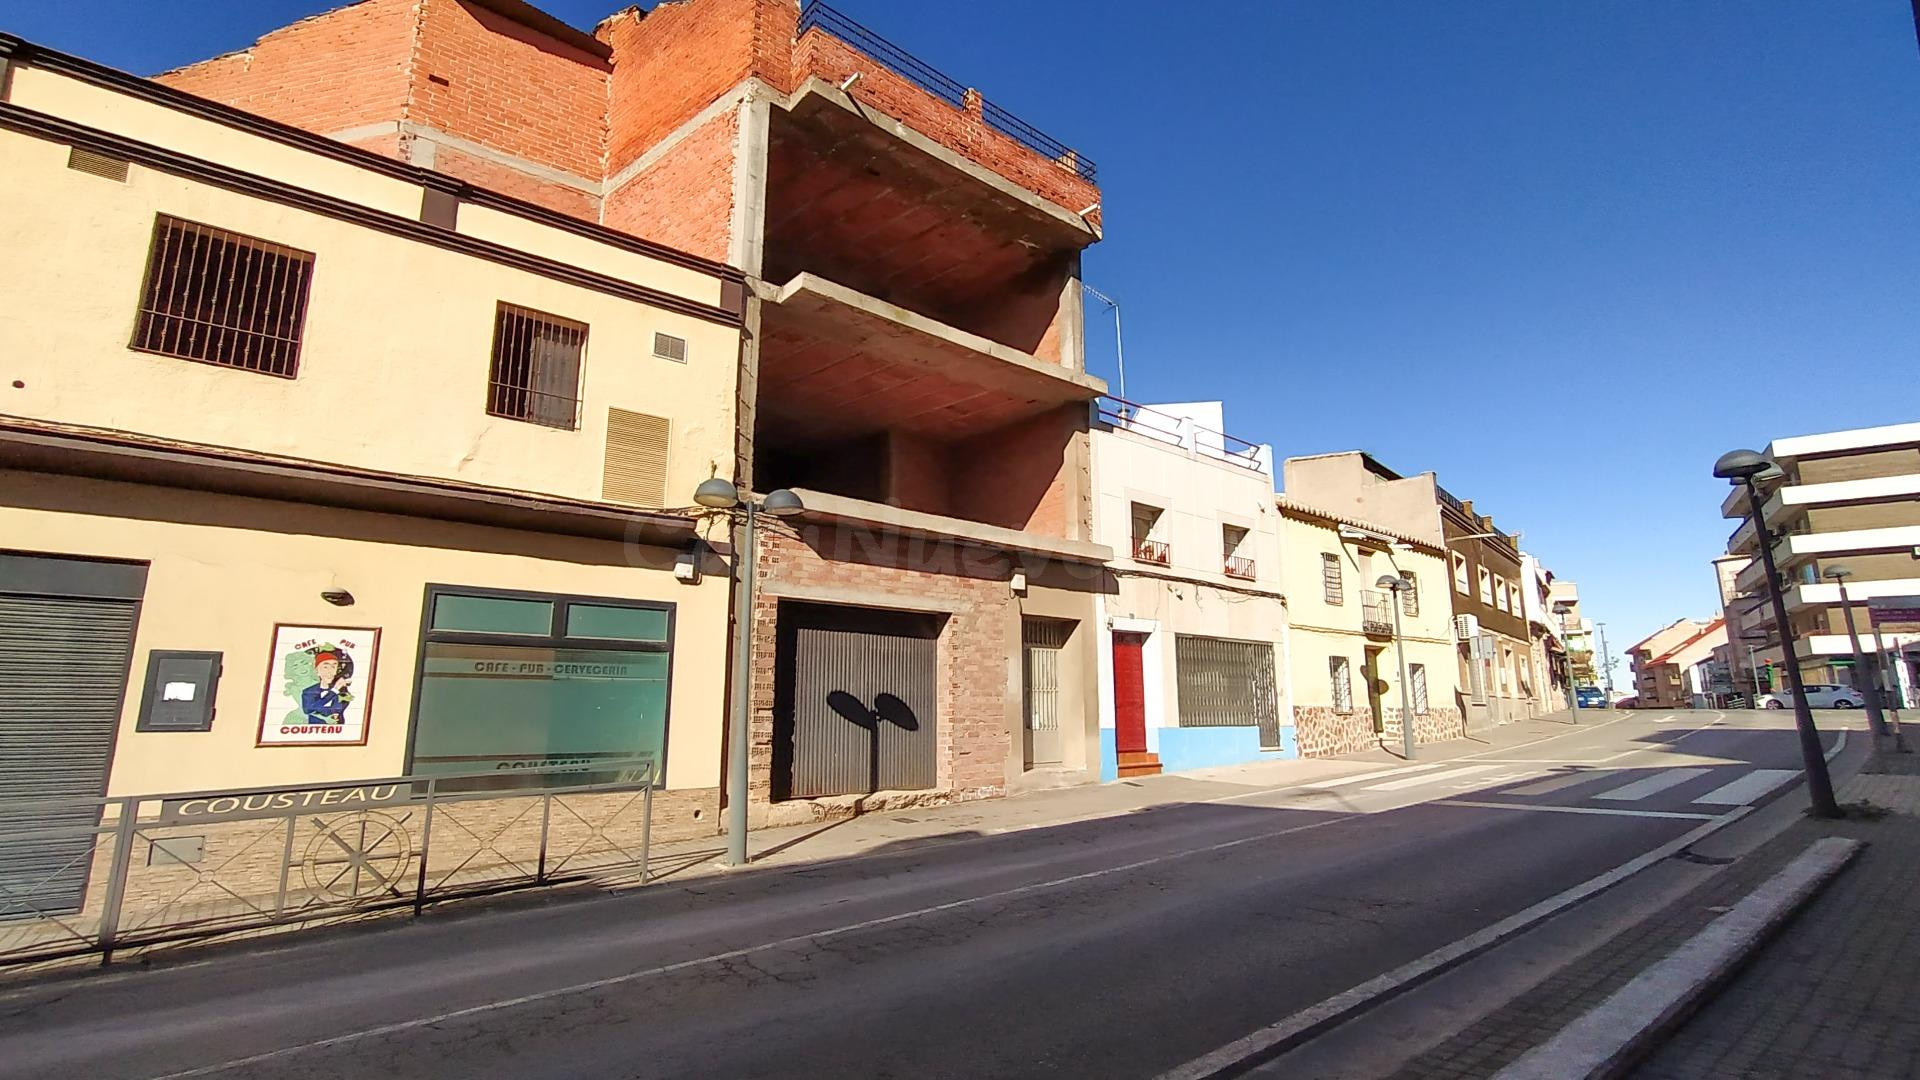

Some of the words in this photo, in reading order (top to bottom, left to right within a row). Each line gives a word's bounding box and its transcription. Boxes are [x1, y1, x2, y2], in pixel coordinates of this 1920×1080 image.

[294, 639, 316, 650] CAFE
[339, 639, 355, 649] PUB
[475, 662, 509, 672] CAFE
[280, 726, 343, 734] COUSTEAU
[177, 784, 399, 816] COUSTEAU
